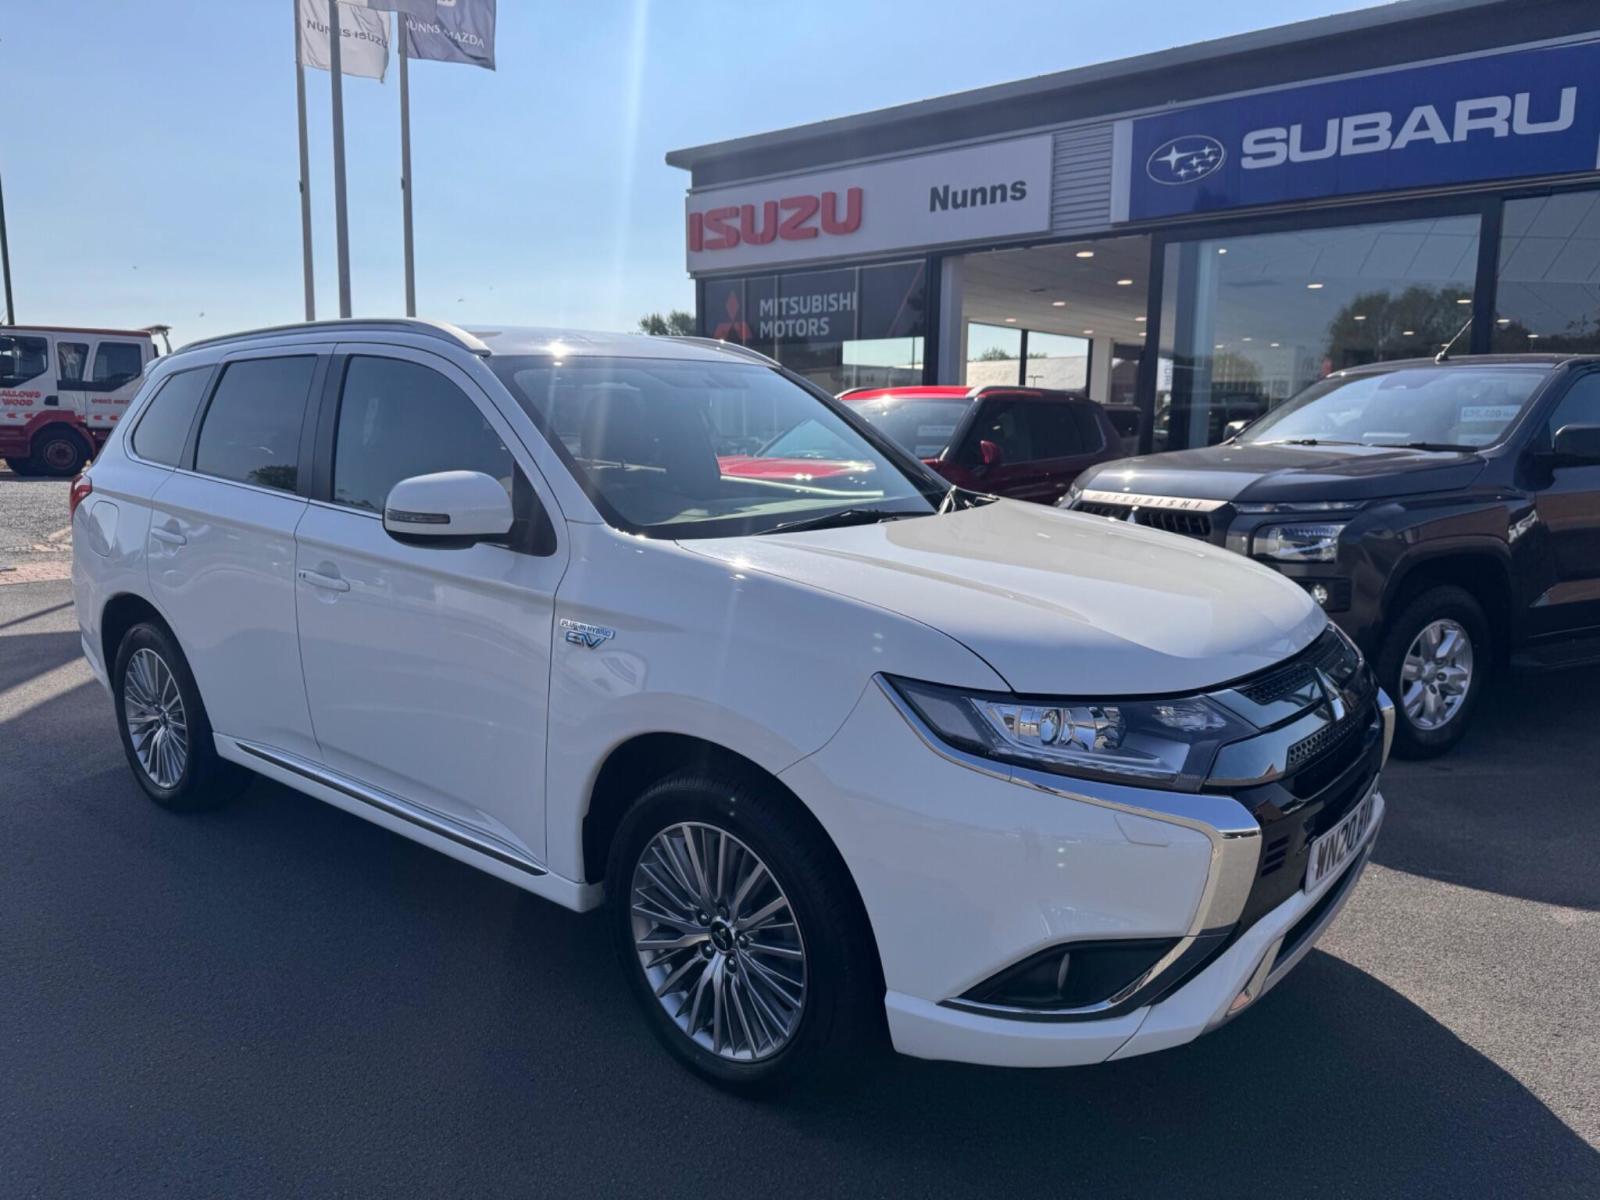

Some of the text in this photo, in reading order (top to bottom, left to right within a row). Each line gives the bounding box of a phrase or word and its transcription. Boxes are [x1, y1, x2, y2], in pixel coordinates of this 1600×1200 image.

[306, 20, 351, 38] NUNS
[1240, 86, 1577, 170] SUBARU
[929, 179, 1027, 212] Nunns
[688, 187, 864, 252] ISUZU
[759, 291, 857, 316] MITSUBISHI
[759, 317, 830, 339] MOTORS
[1091, 492, 1203, 509] MITSUBISHI
